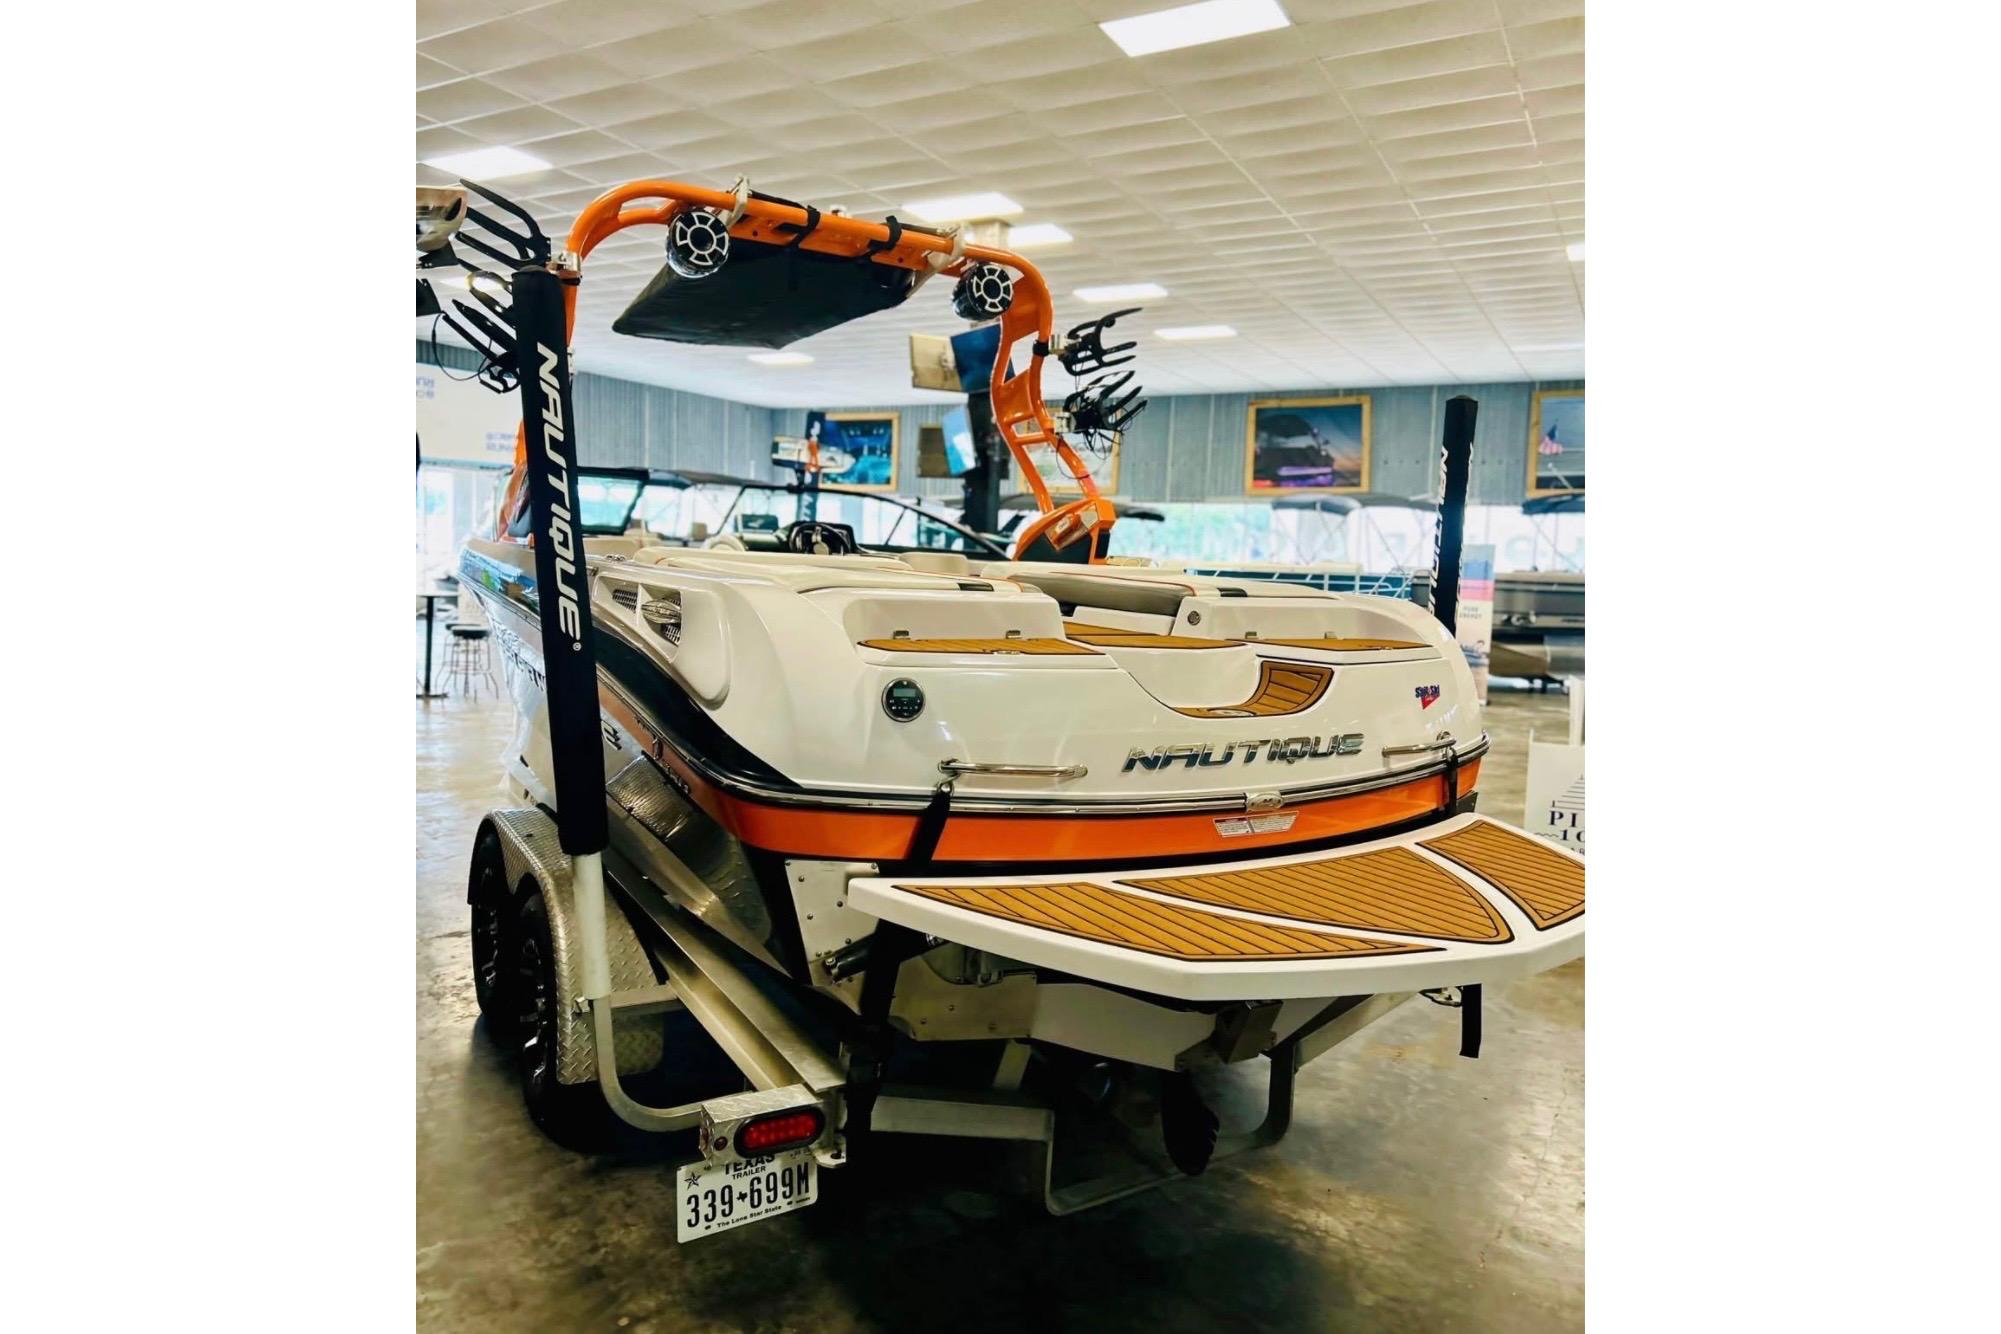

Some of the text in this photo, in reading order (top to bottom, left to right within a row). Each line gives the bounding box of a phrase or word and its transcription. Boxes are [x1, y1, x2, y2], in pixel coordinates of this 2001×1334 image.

[536, 341, 581, 642] NAUTIQUE
[1121, 733, 1364, 773] NAUTIQUE
[732, 1165, 767, 1180] TRAILER
[686, 1184, 734, 1228] 339
[717, 1220, 730, 1228] The
[764, 1205, 782, 1214] State
